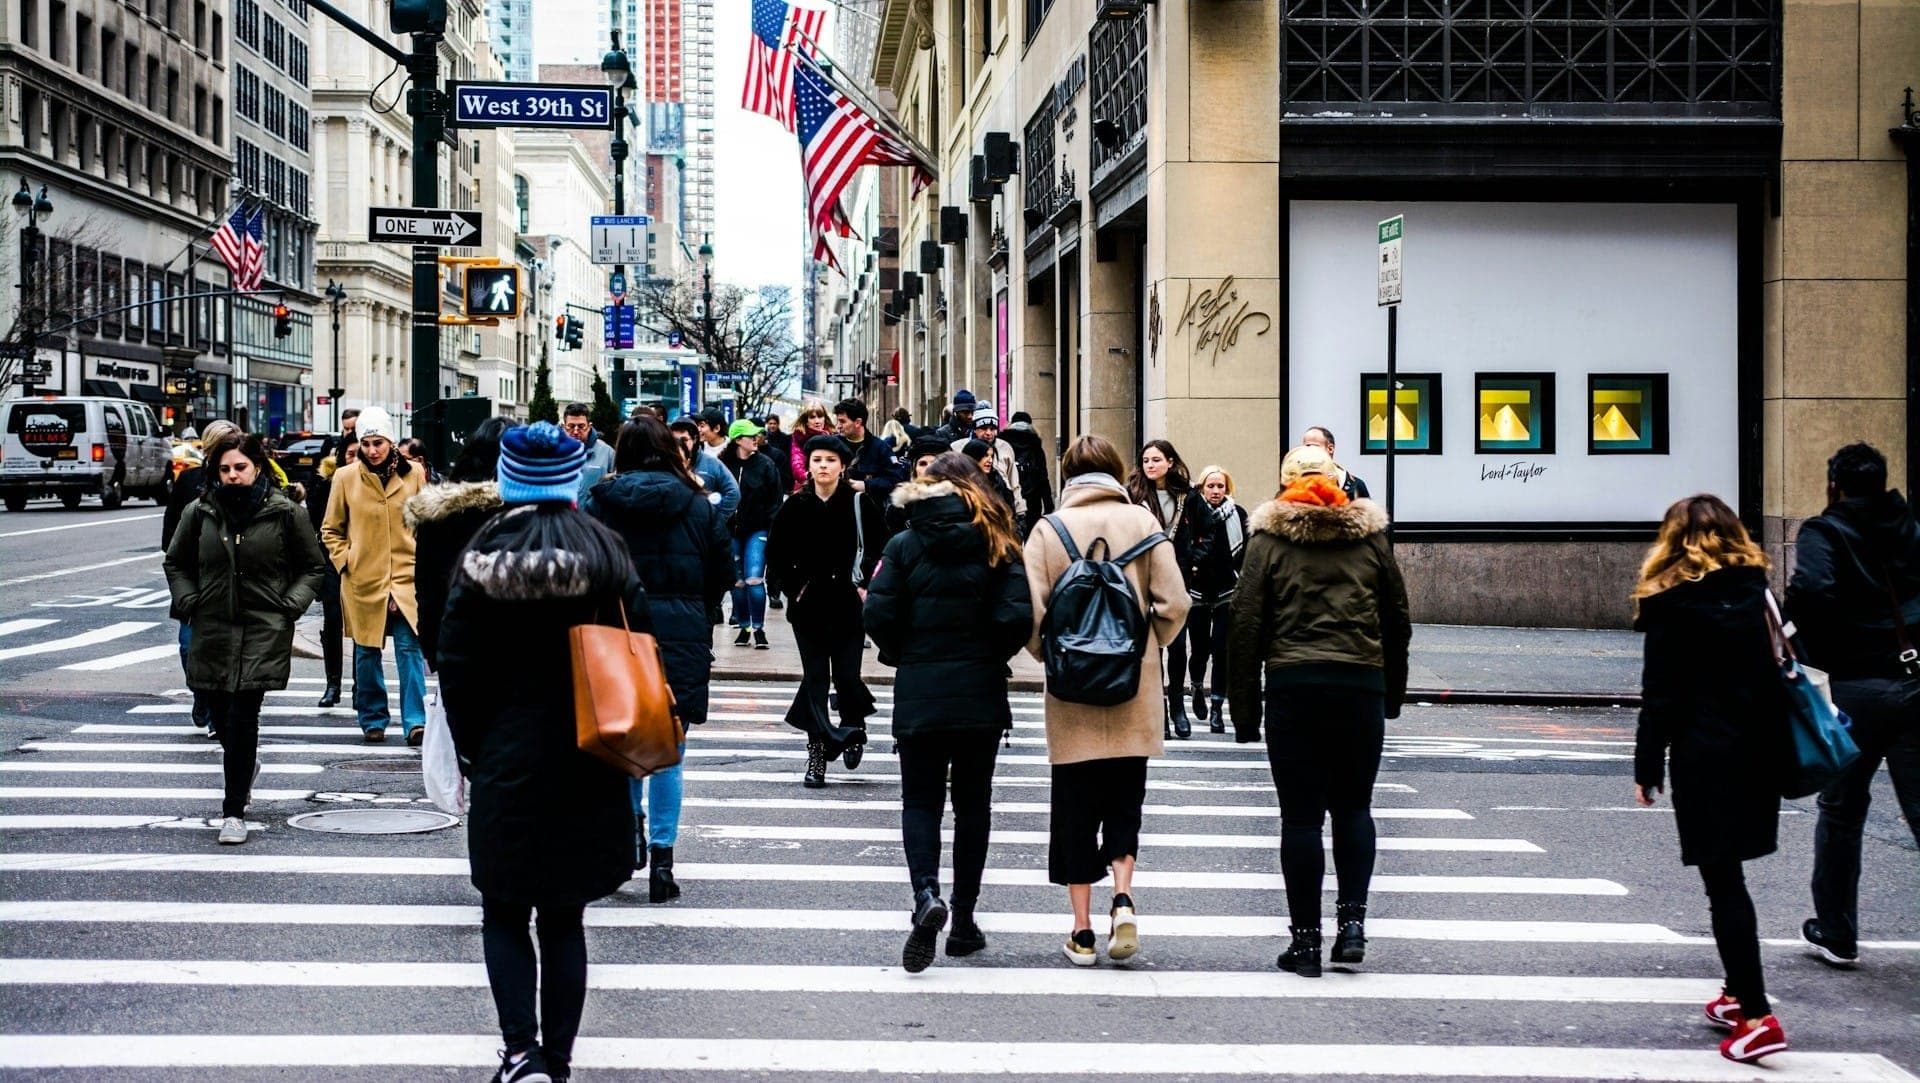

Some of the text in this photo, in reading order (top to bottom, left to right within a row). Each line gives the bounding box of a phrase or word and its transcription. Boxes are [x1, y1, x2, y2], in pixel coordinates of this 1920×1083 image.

[462, 95, 604, 118] West 39th St
[385, 218, 465, 235] ONE WAY
[24, 433, 67, 442] FILMS
[1481, 463, 1505, 481] Lord
[1510, 461, 1548, 483] Taylor
